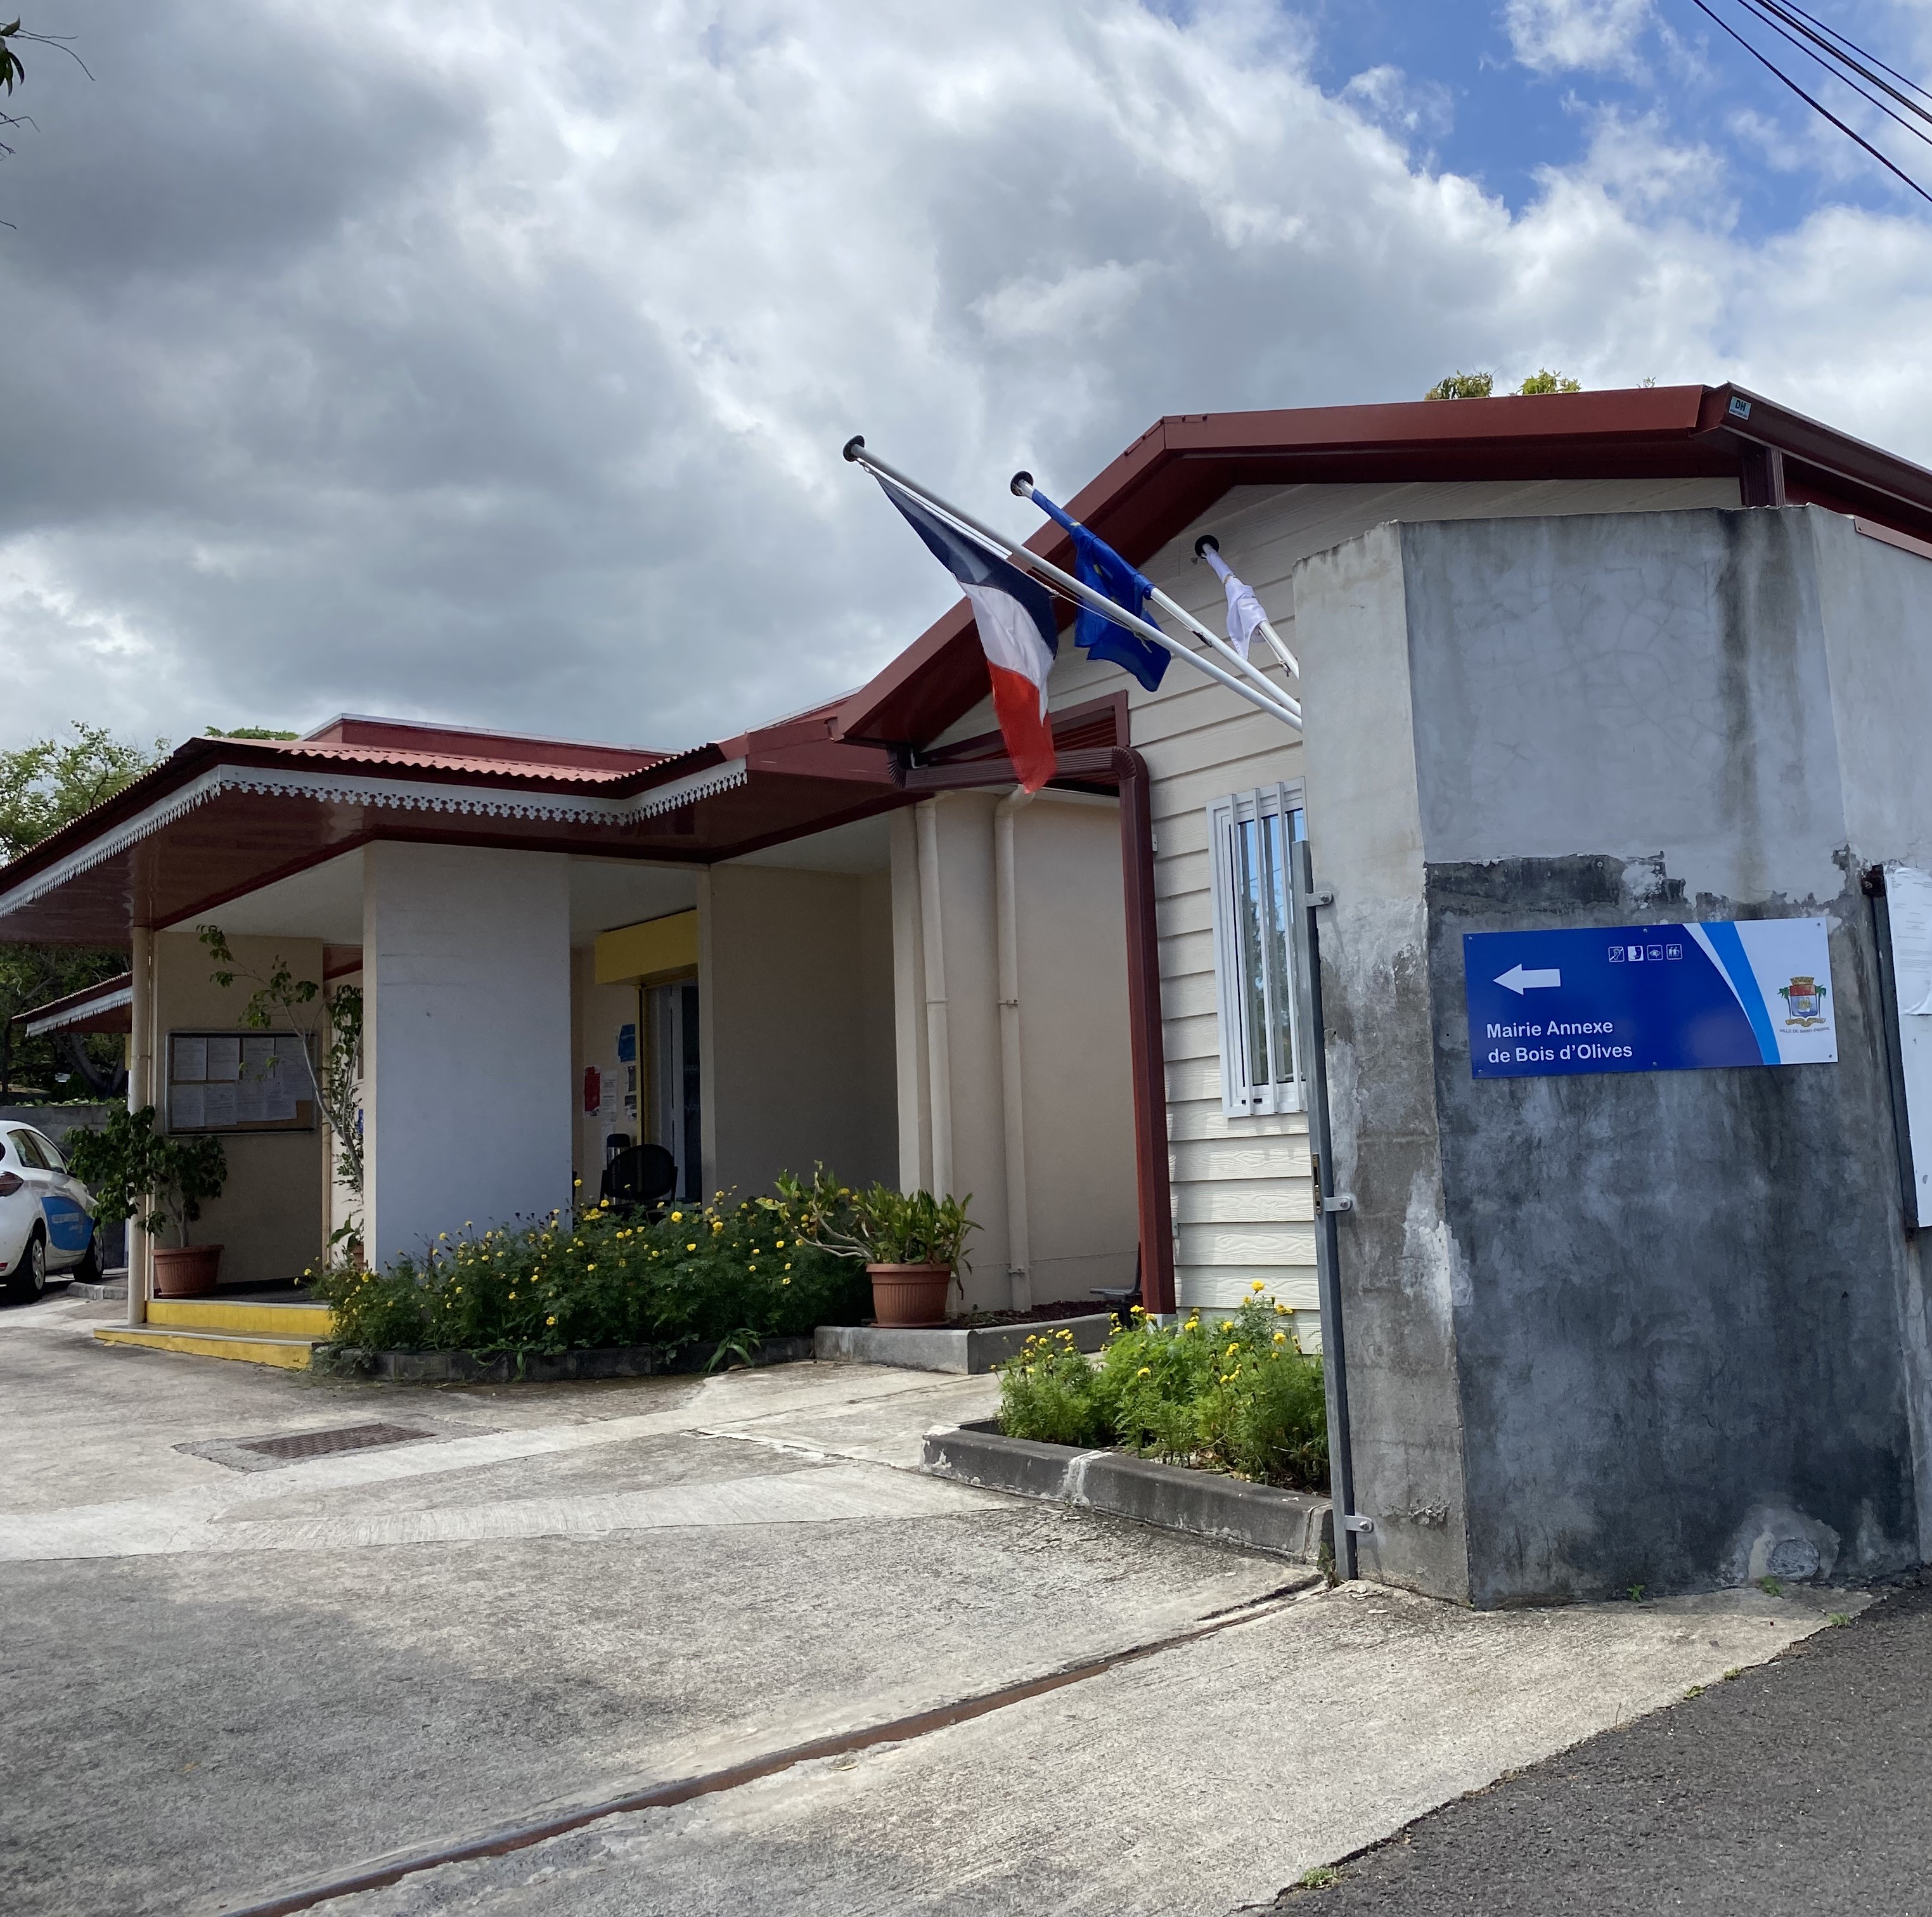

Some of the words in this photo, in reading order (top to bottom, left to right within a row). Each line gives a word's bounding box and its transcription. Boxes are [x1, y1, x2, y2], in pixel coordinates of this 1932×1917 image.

[1486, 1022, 1542, 1038] Mairie
[1547, 1021, 1613, 1036] Annexe
[1488, 1048, 1510, 1063] de
[1516, 1046, 1555, 1062] Bois
[1559, 1043, 1633, 1060] d’Olives
